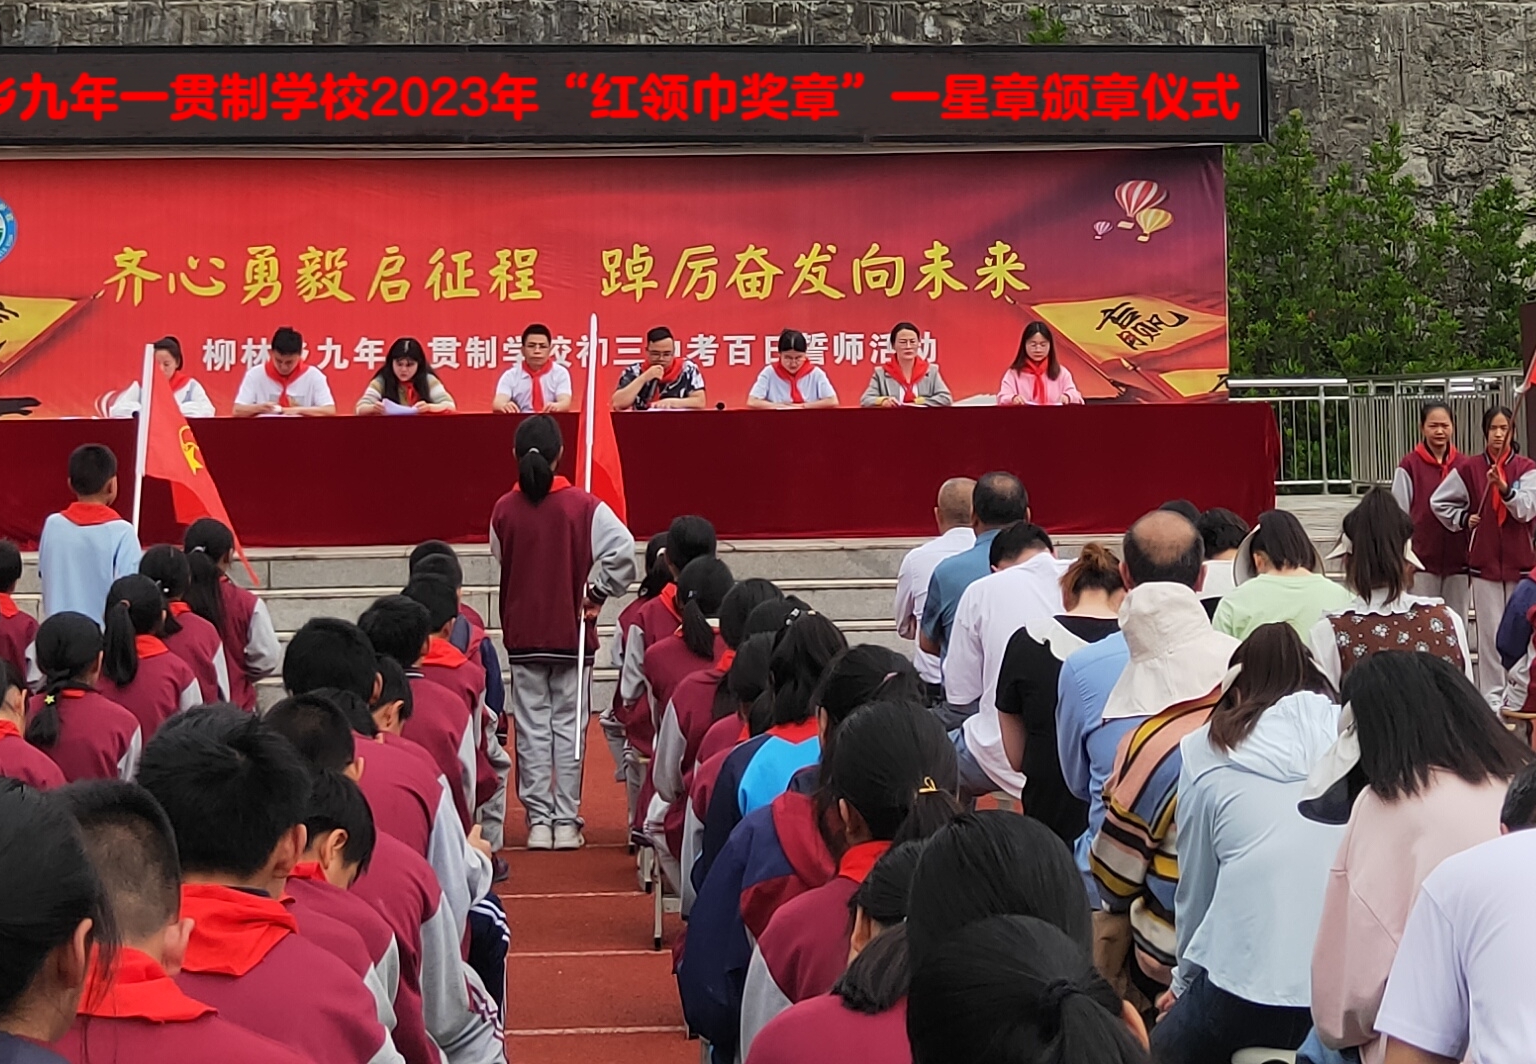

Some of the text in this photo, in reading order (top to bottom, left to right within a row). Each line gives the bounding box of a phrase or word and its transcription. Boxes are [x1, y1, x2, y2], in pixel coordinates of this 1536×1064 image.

[104, 240, 1031, 306] 齐心勇毅启征程 踔厉奋发向未来
